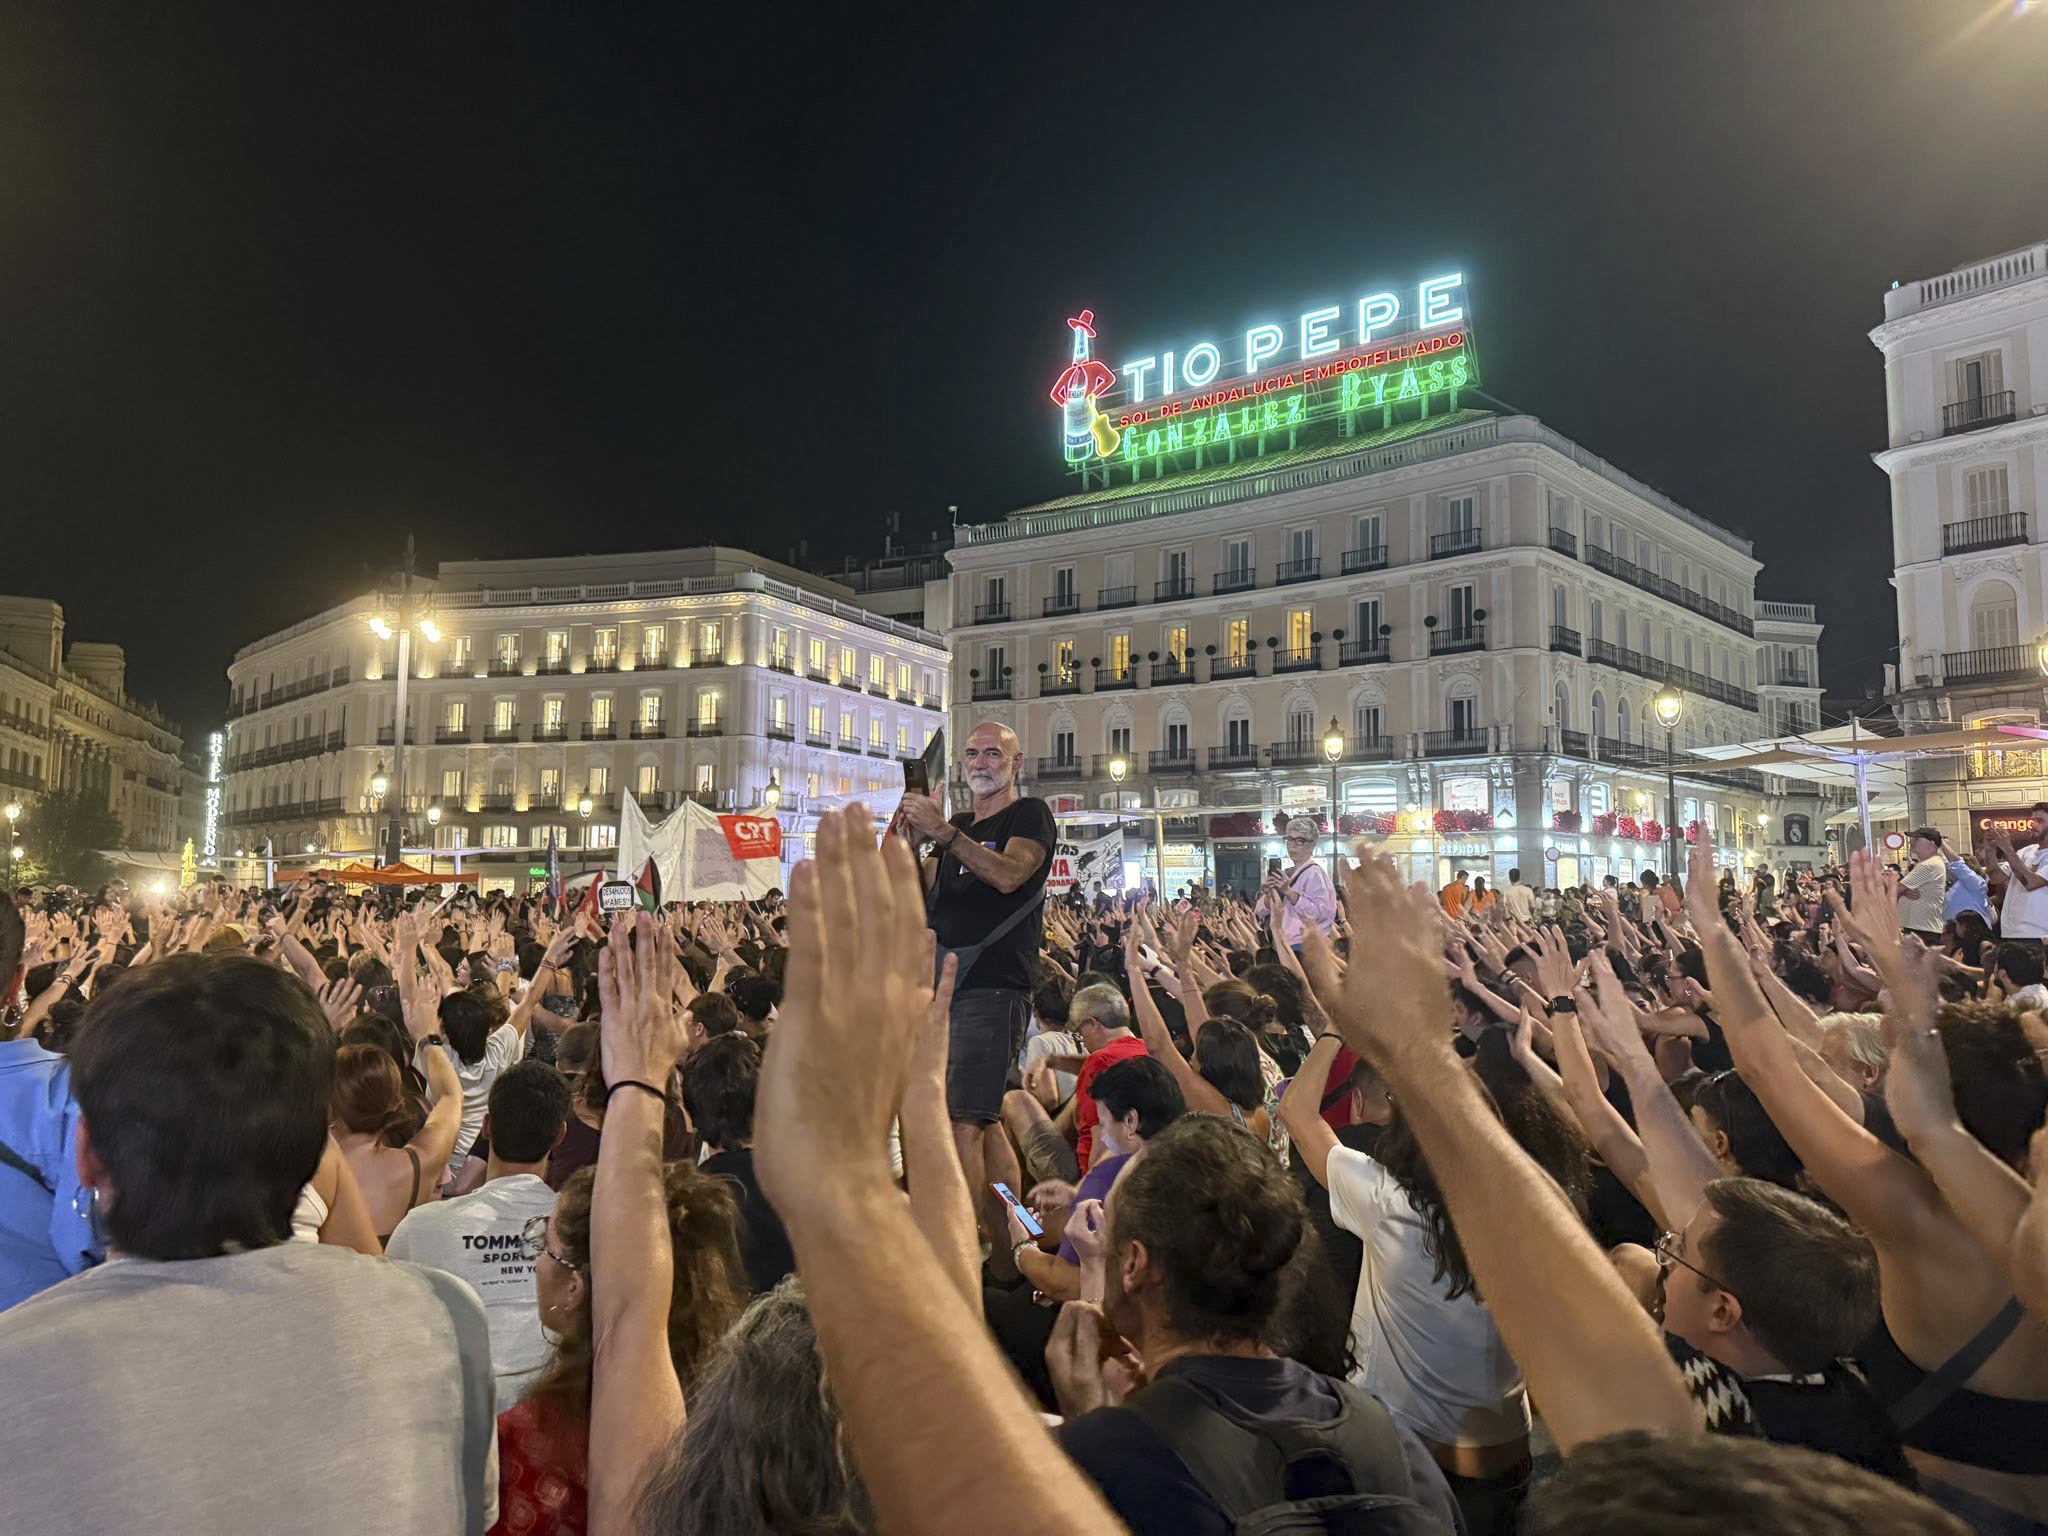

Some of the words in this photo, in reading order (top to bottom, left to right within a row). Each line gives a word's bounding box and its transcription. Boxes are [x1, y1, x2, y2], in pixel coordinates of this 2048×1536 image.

[1122, 342, 1221, 403] TIO
[1246, 272, 1463, 374] PEPE
[1120, 410, 1155, 428] SOL
[1160, 401, 1183, 418] DE
[1190, 373, 1296, 411] ANDALUCIA
[1303, 332, 1463, 383] EMBOTELLADO
[1123, 394, 1303, 461] GONZALEZ
[1341, 356, 1468, 413] BYASS
[210, 732, 223, 783] HOTEL
[204, 788, 221, 856] MODERNO
[1439, 843, 1488, 855] SEPHORA
[501, 1266, 524, 1275] NEW
